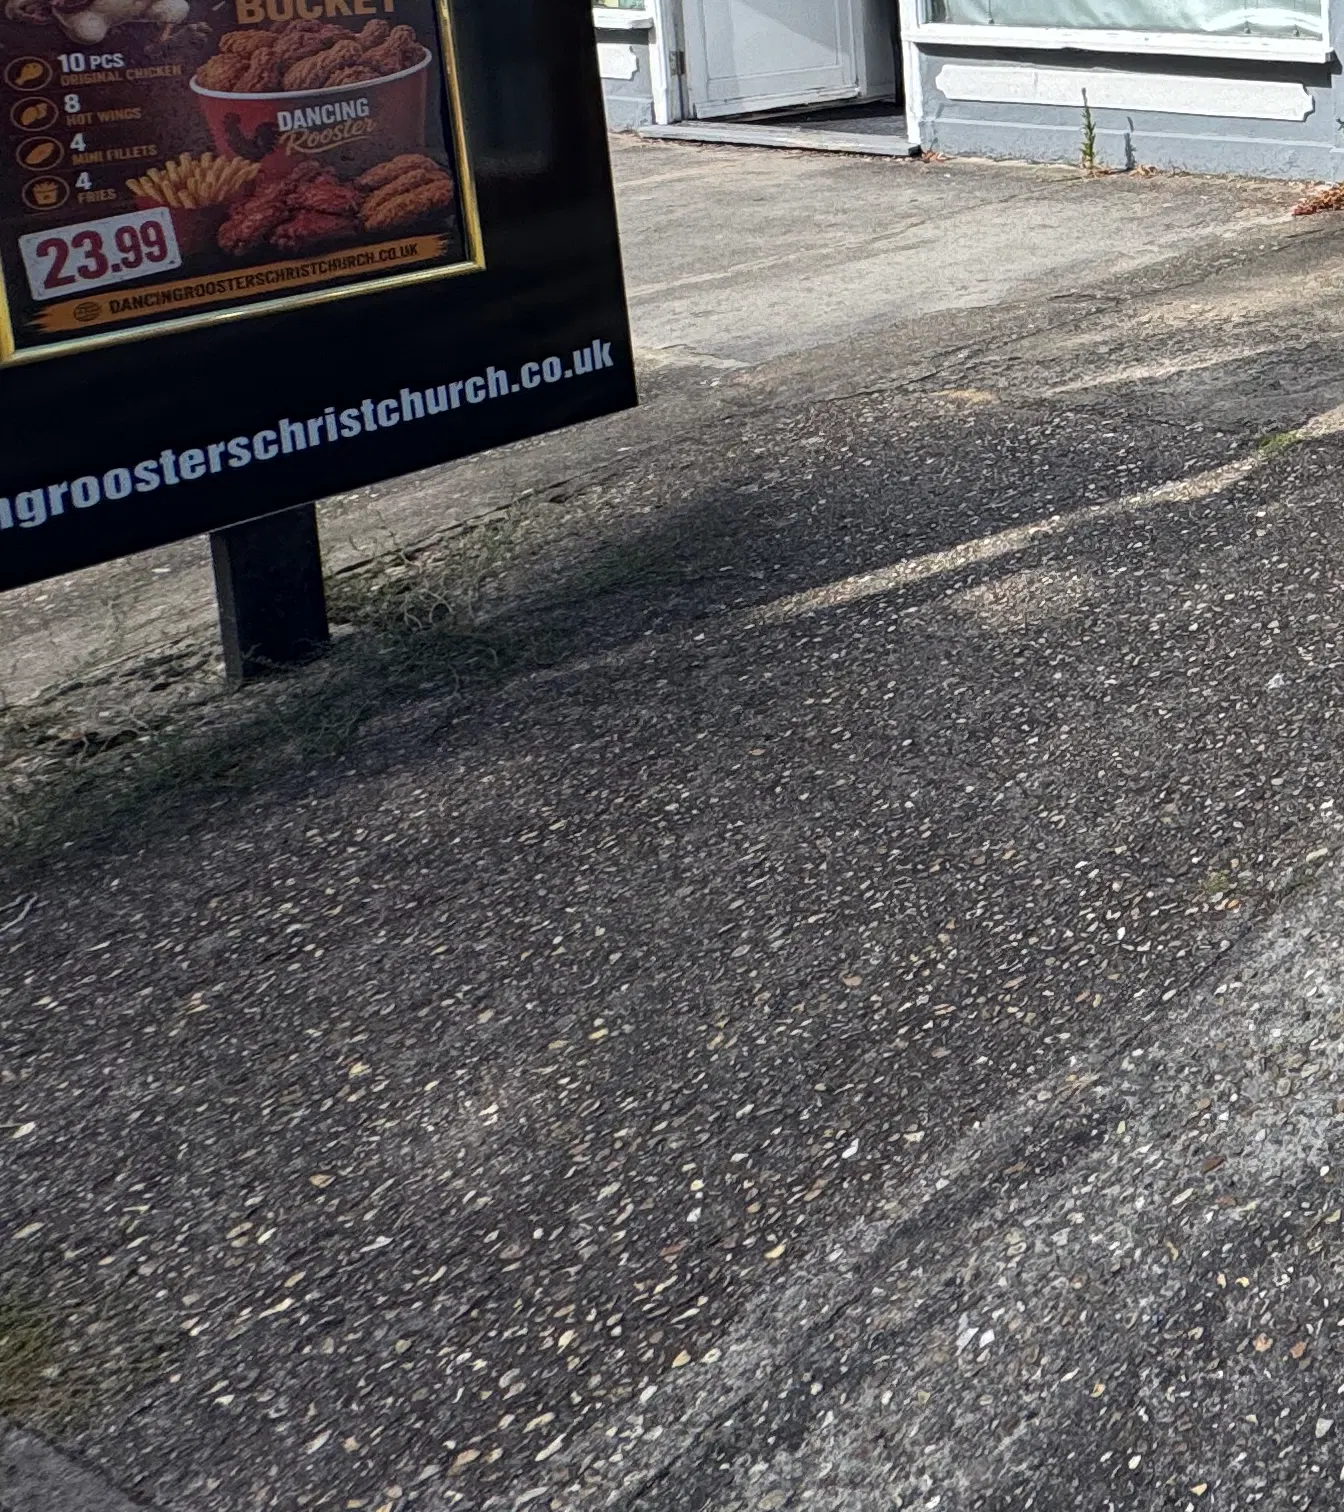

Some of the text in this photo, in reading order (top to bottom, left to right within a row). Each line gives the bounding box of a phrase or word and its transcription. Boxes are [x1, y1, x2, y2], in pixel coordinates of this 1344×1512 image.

[57, 53, 125, 73] 10 PCS
[60, 64, 182, 87] ORIGINAL CHICKEN
[64, 94, 81, 113] 8
[66, 108, 141, 126] HOT WINGS
[277, 98, 369, 132] DANCING
[70, 133, 86, 152] 4
[278, 117, 376, 155] Rooster
[72, 144, 157, 166] MINI FILLETS
[75, 172, 92, 190] 4
[77, 188, 116, 204] FRIES
[36, 220, 169, 289] 23.99
